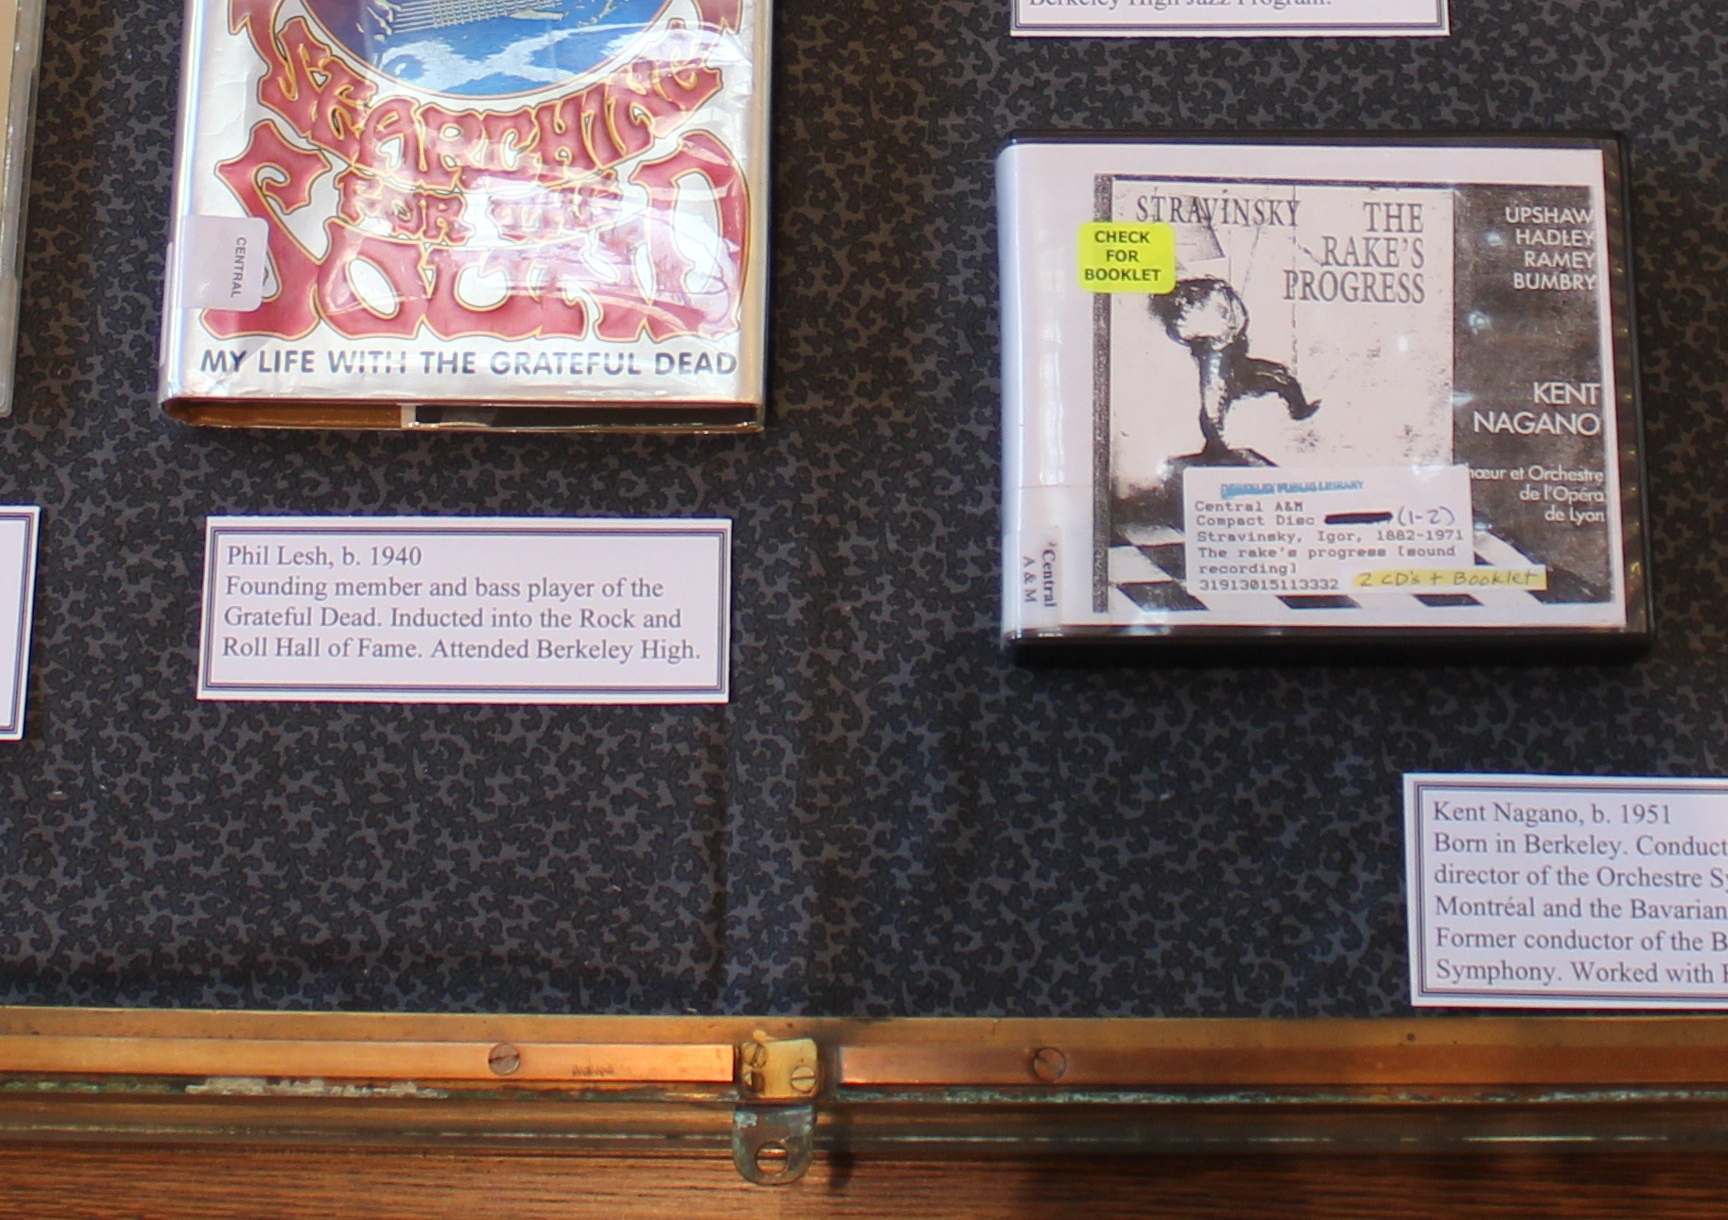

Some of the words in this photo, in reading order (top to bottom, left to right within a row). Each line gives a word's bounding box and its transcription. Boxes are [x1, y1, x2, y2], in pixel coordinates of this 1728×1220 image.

[1136, 194, 1301, 227] STRAVINSKY
[1364, 202, 1424, 233] THE
[1505, 207, 1593, 224] UPSHAW
[1094, 230, 1151, 245] CHECK
[1516, 229, 1595, 245] HADLEY
[1105, 249, 1139, 263] FOR
[1525, 251, 1596, 268] RAMEY
[1084, 268, 1162, 283] BOOKLET
[1513, 273, 1597, 291] BUMBRY
[1283, 270, 1425, 303] PROGRESS
[201, 352, 245, 373] MY
[258, 352, 317, 374] LIFE
[329, 350, 407, 374] WITH
[421, 350, 476, 374] THE
[490, 352, 643, 374] GRATEFUL
[655, 352, 736, 374] DEAD
[1534, 382, 1600, 405] KENT
[1474, 411, 1600, 436] NAGANO
[1197, 532, 1303, 543] Stravinsky,
[1318, 532, 1363, 542] Igor,
[1377, 530, 1463, 541] 1882-1971
[227, 544, 269, 566] Phil
[276, 545, 334, 570] Lesh,
[342, 545, 361, 566] b.
[371, 545, 422, 567] 1940
[1433, 800, 1486, 822] Kent
[1492, 801, 1585, 829] Nagano,
[1590, 803, 1611, 824] b.
[1621, 803, 1670, 825] 1951
